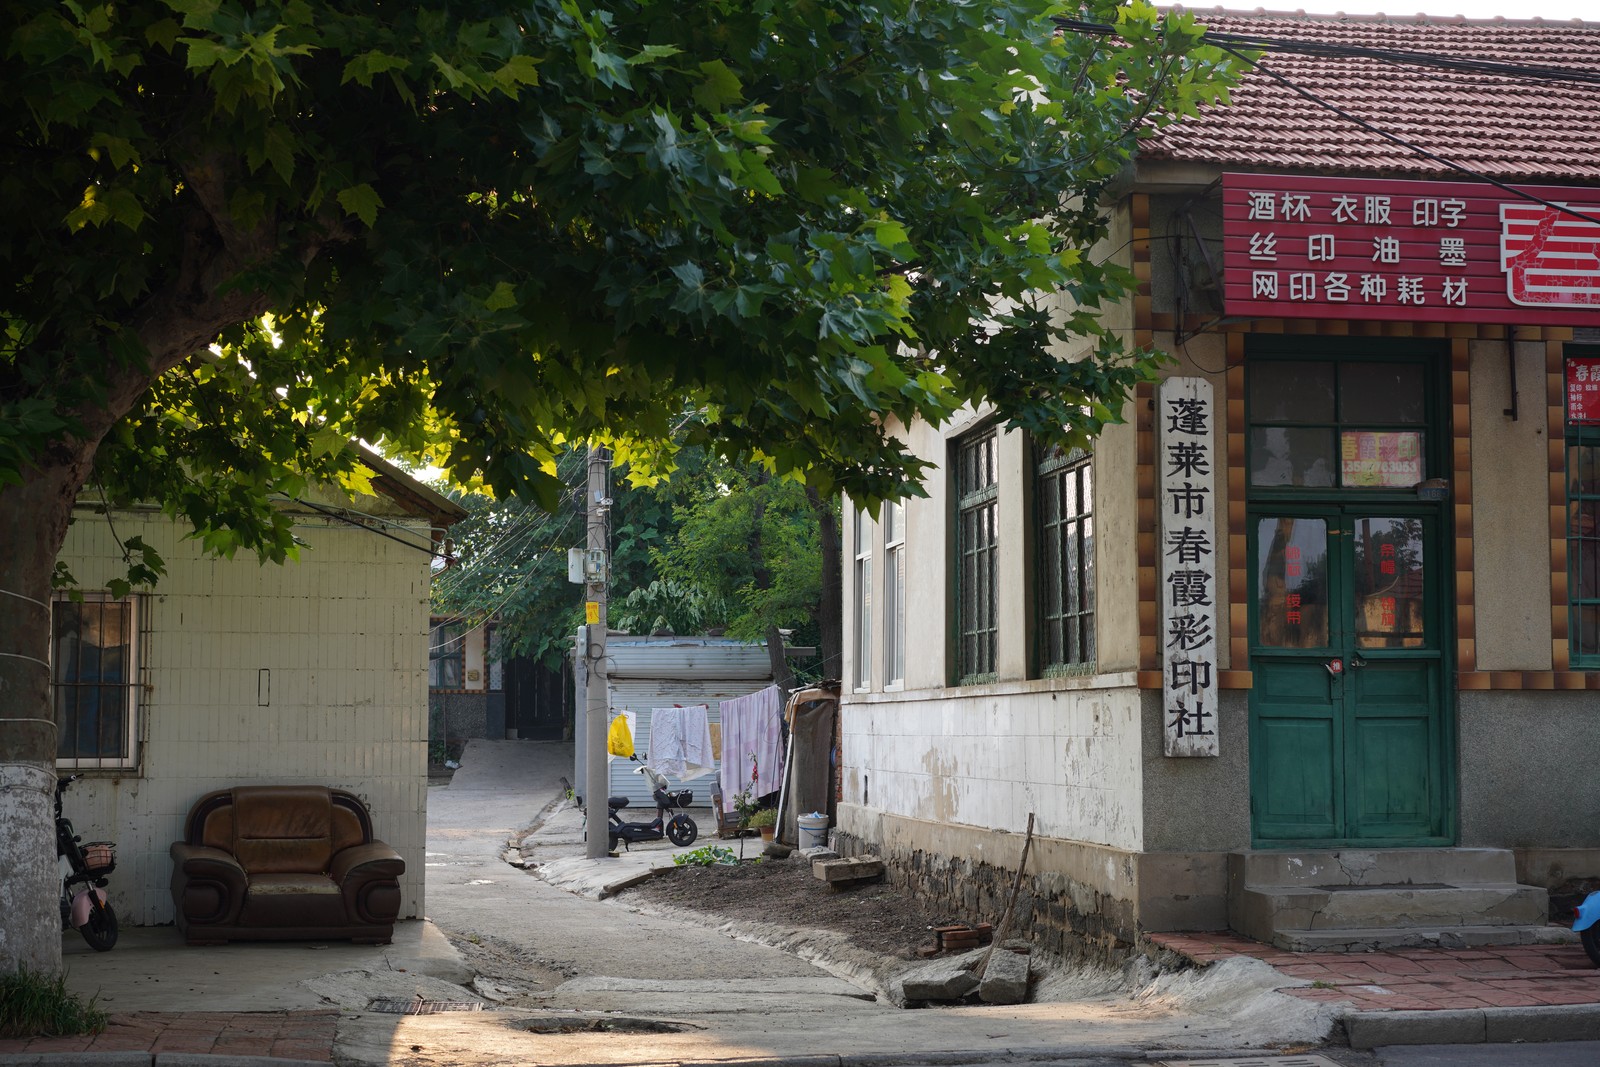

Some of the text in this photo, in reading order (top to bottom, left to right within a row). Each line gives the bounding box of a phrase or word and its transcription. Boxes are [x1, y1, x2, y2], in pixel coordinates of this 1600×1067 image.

[1247, 191, 1467, 228] 酒杯 衣服 印字
[1249, 232, 1467, 267] 丝印油墨
[1252, 270, 1469, 306] 网印各种耗材
[1341, 435, 1417, 459] 春霞彩印
[1166, 398, 1214, 738] 蓬莱市春霞彩印社
[1380, 543, 1396, 575] 条幅
[1285, 593, 1302, 625] 绶带
